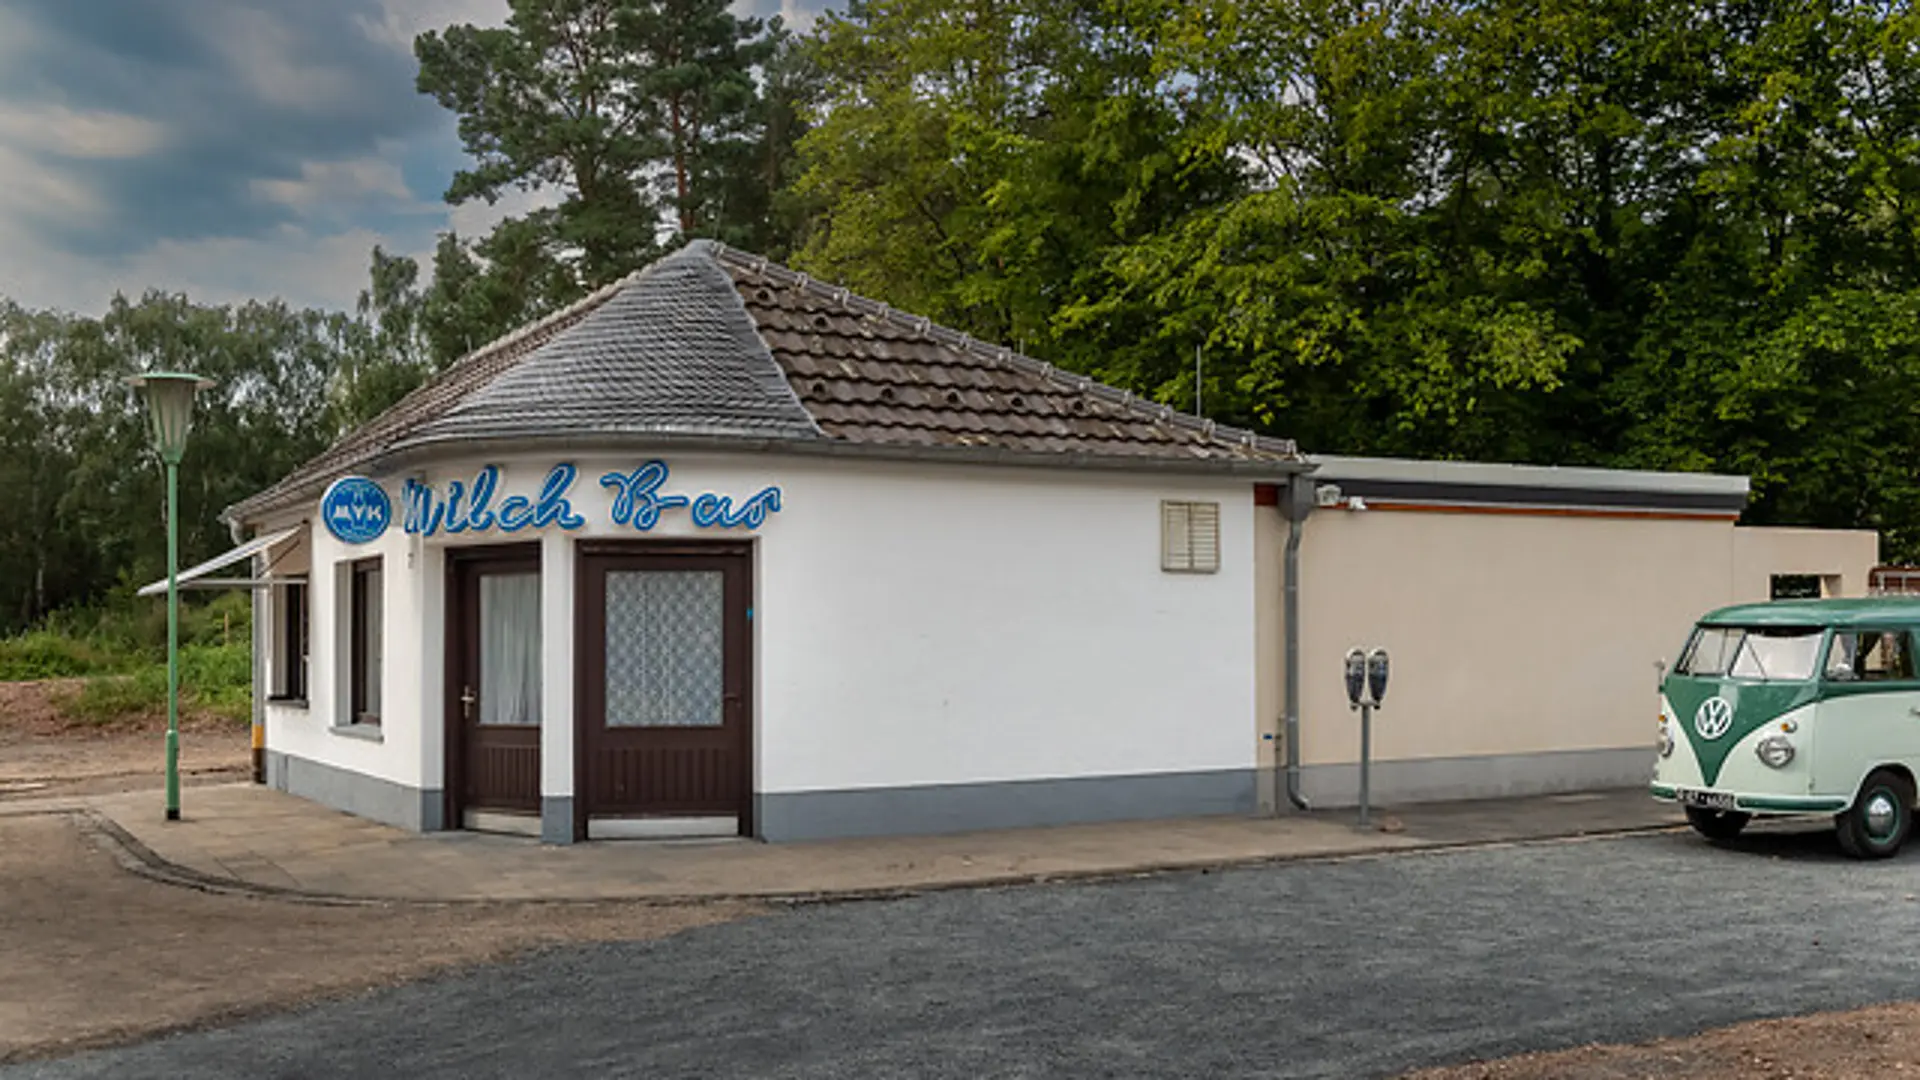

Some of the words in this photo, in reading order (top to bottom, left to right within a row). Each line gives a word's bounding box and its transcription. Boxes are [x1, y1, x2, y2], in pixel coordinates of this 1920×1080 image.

[402, 463, 585, 536] Milch
[600, 460, 781, 530] Bar
[1696, 698, 1731, 739] VW
